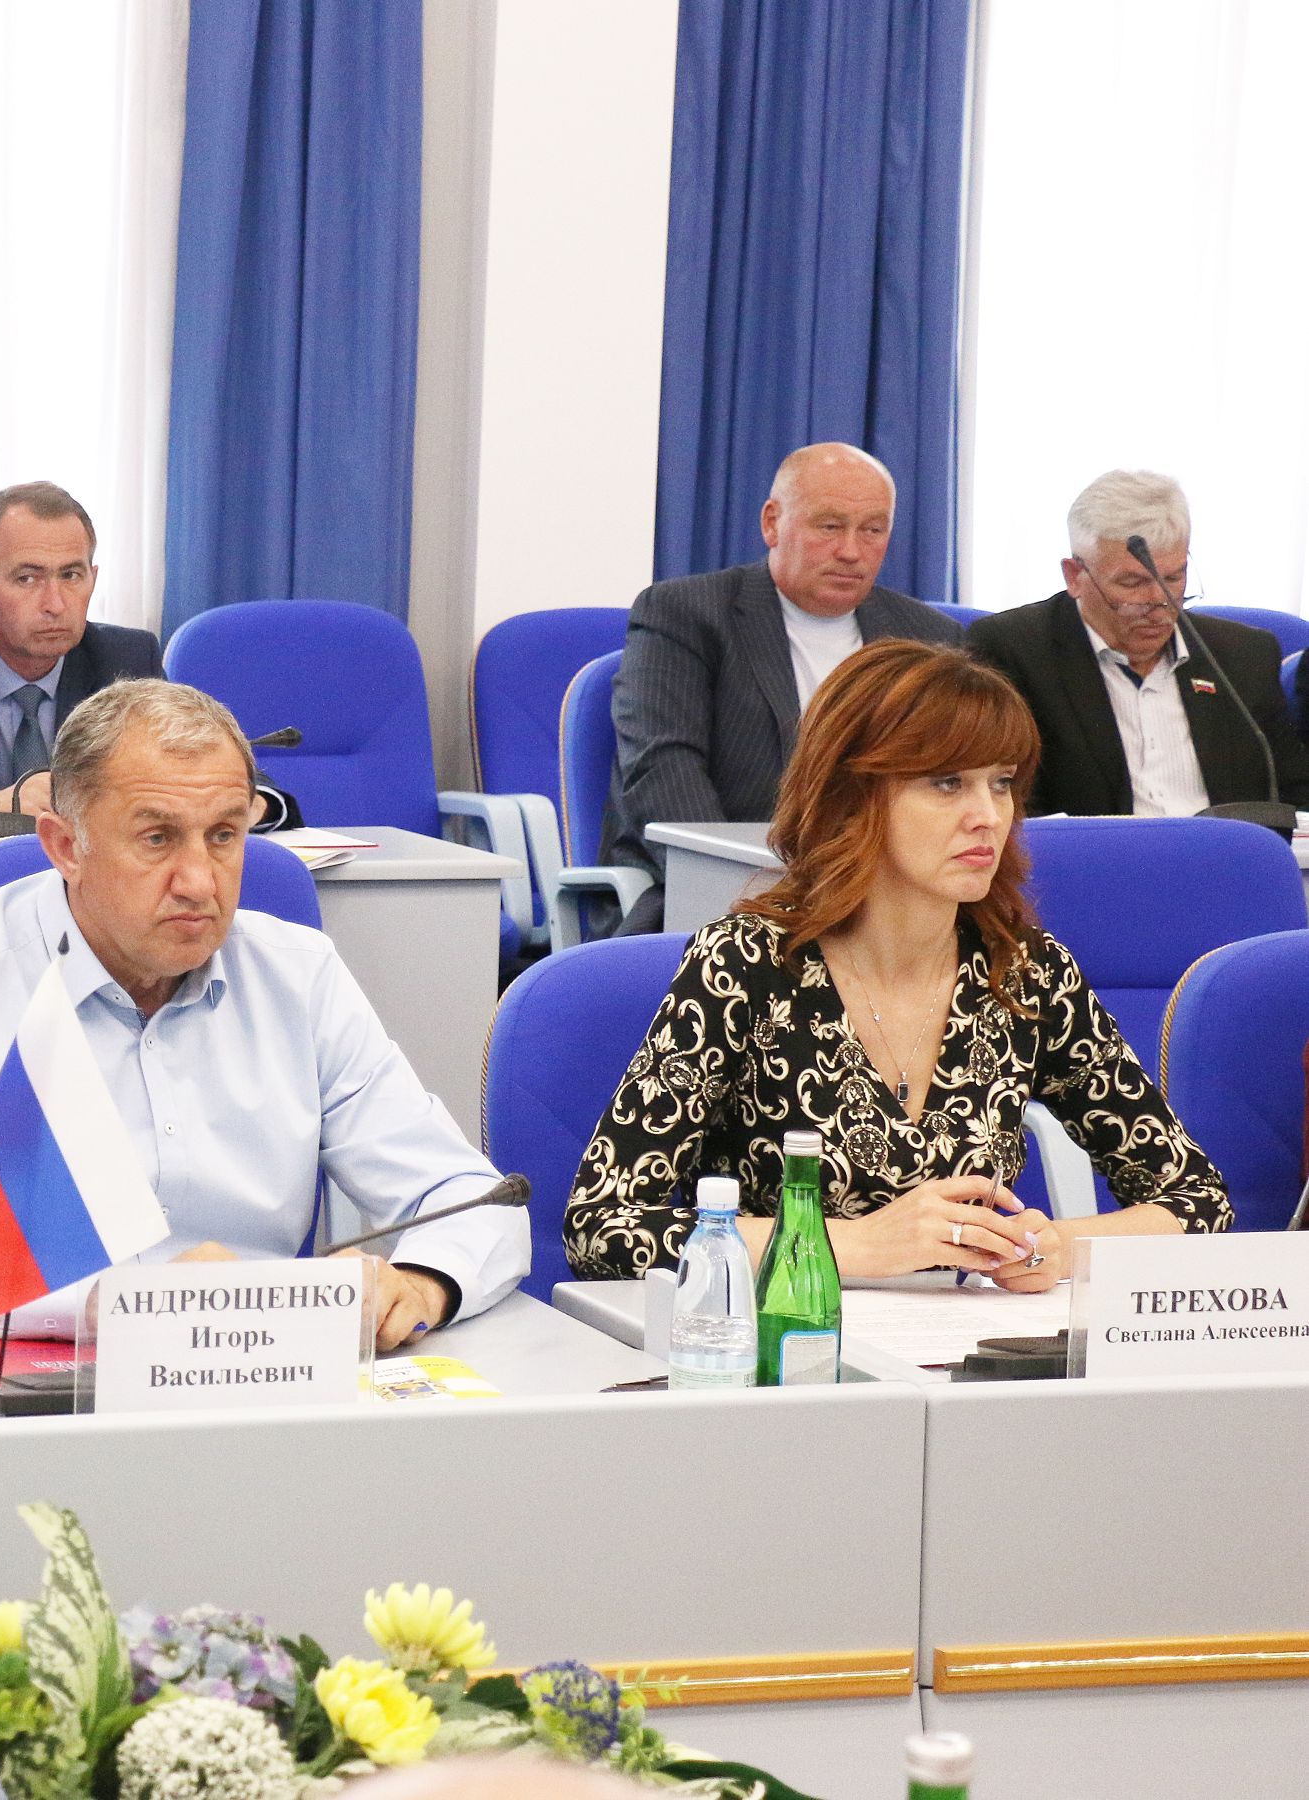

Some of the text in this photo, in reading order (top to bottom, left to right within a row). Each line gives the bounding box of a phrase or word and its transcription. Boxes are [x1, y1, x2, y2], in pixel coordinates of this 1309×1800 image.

[110, 1284, 356, 1318] АНДРЮЩЕНКО
[1131, 1287, 1288, 1314] ТЕРЕХОВА
[190, 1325, 275, 1353] Игорь
[1105, 1324, 1309, 1343] Светлана Алексеевна
[149, 1363, 314, 1388] Васильевич
